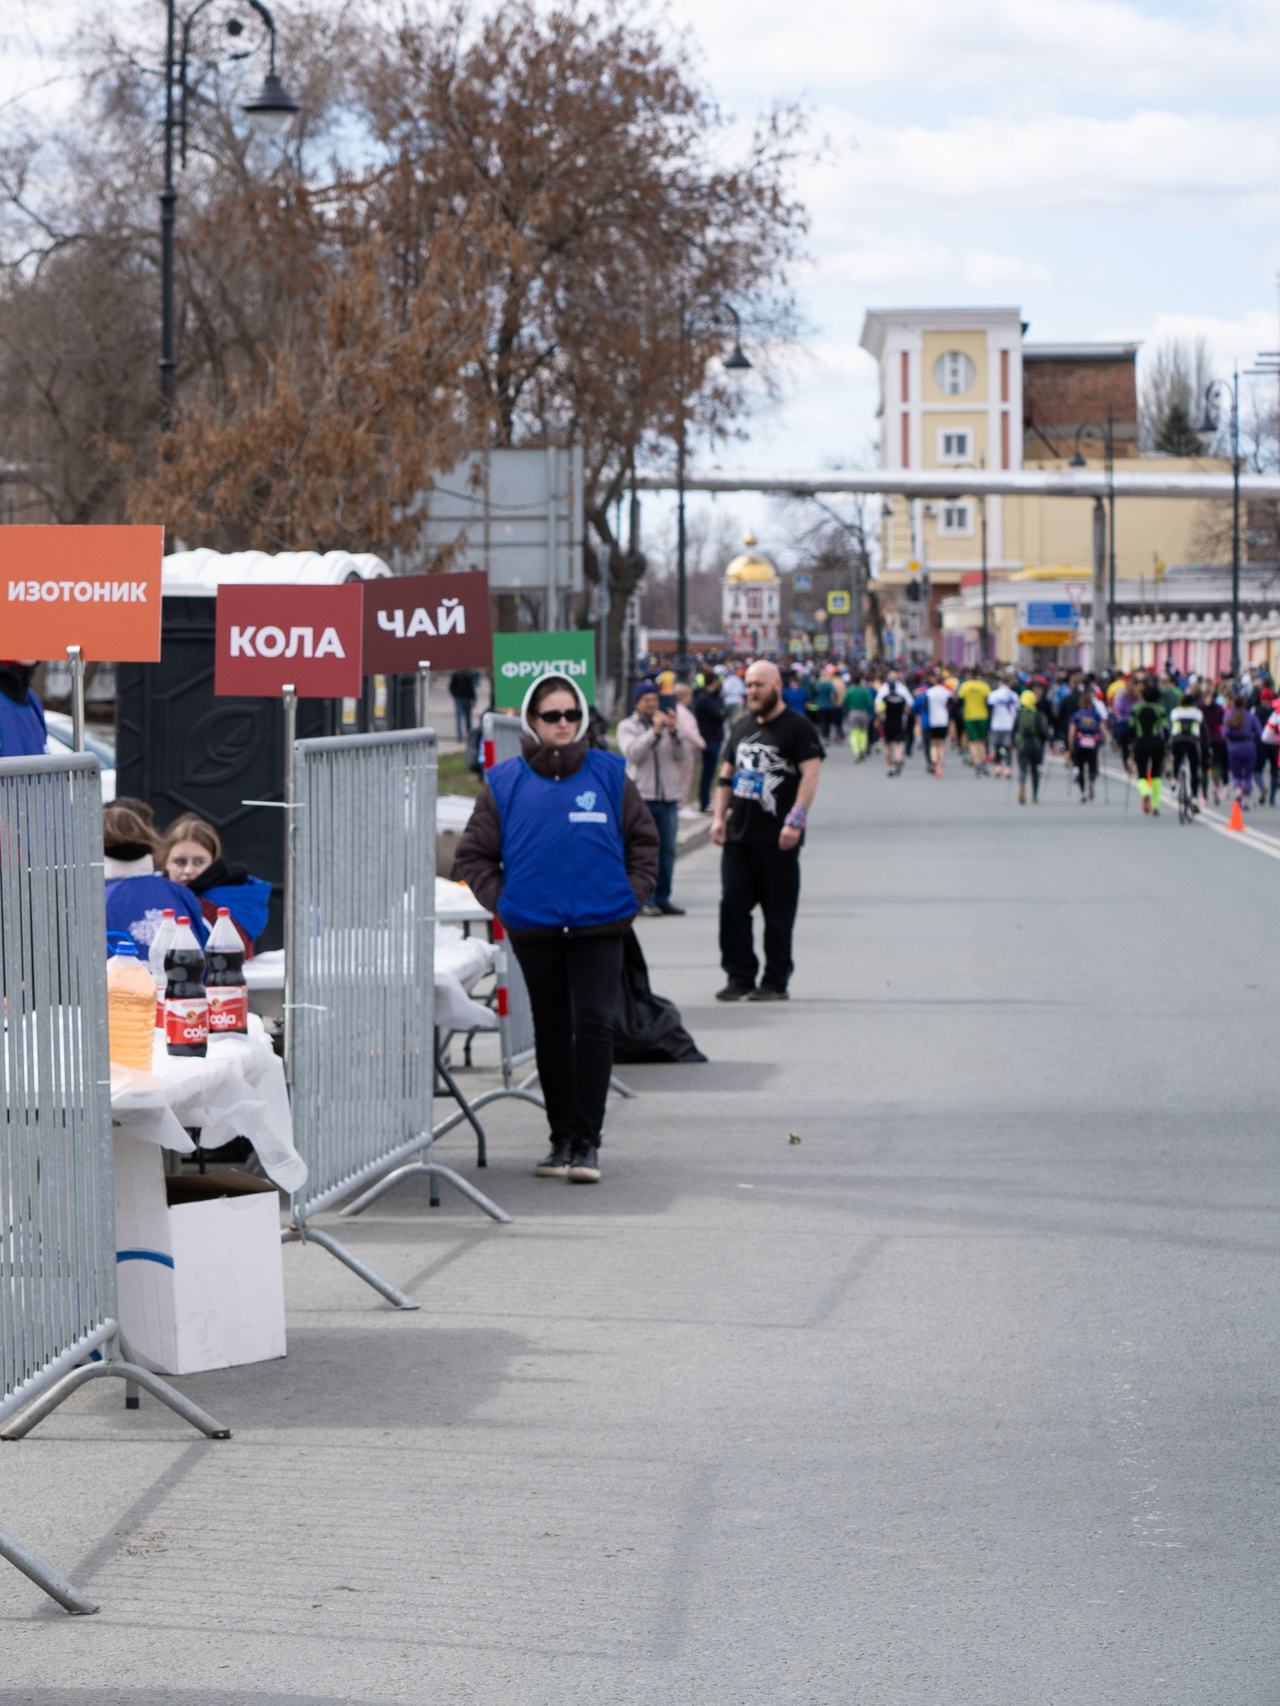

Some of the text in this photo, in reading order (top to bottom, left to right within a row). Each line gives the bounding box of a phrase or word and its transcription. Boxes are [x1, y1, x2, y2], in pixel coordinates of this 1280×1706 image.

[7, 580, 148, 603] ИЗОТОНИК
[376, 597, 467, 638] ЧАЙ
[229, 625, 347, 659] КОЛА
[501, 658, 588, 678] ФРУКТЫ
[209, 1011, 236, 1025] cola
